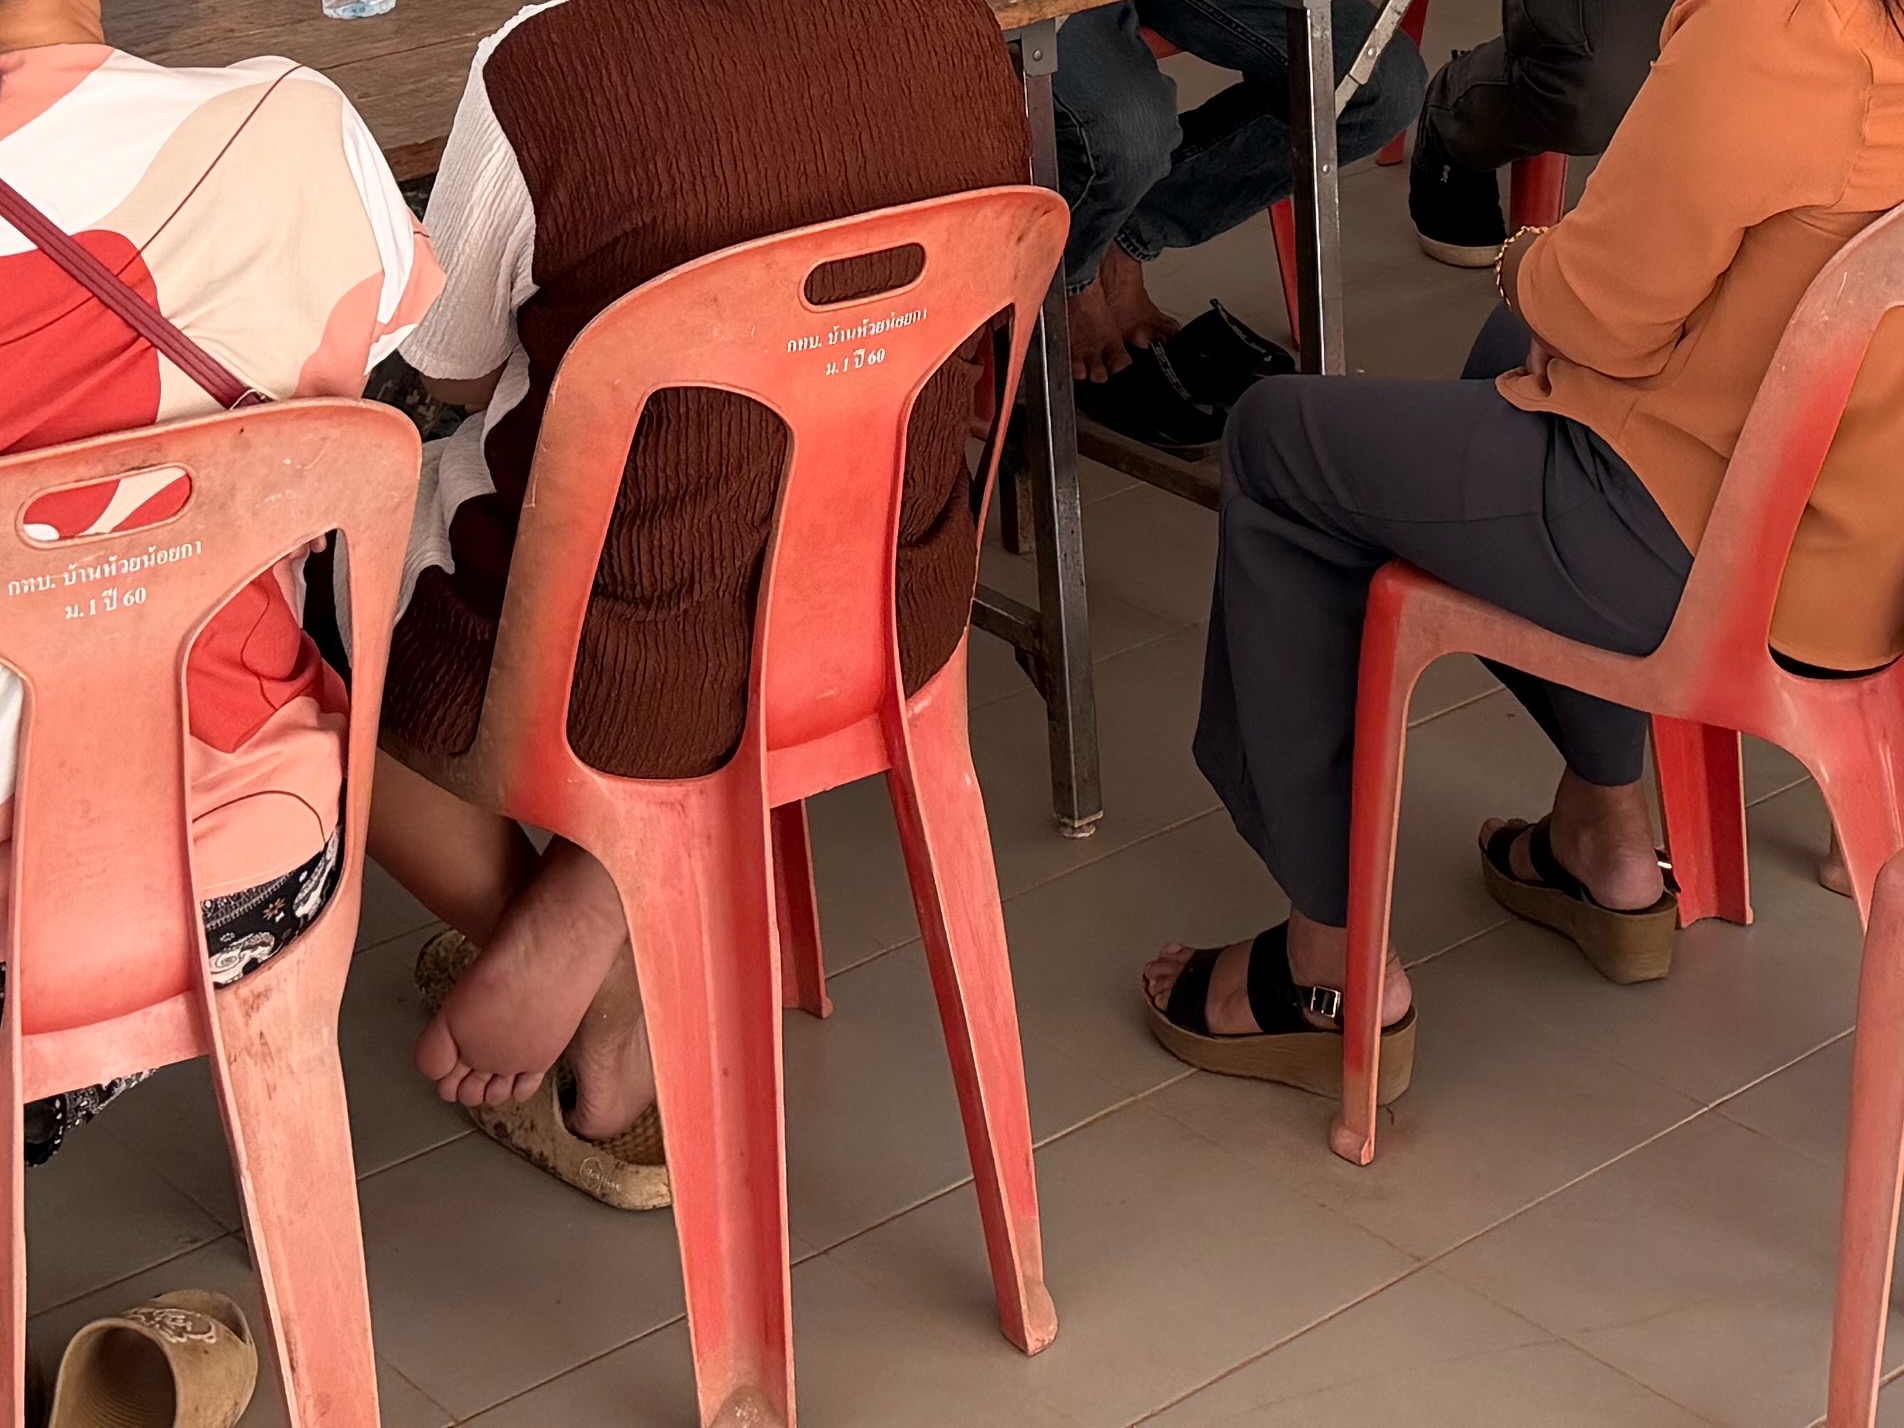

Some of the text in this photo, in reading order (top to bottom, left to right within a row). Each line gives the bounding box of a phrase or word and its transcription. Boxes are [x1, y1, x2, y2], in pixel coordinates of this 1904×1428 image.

[853, 349, 867, 370] ปี
[867, 348, 886, 366] 60
[7, 572, 56, 597] กทบ.
[64, 586, 147, 620] ม. 1 ปี 60
